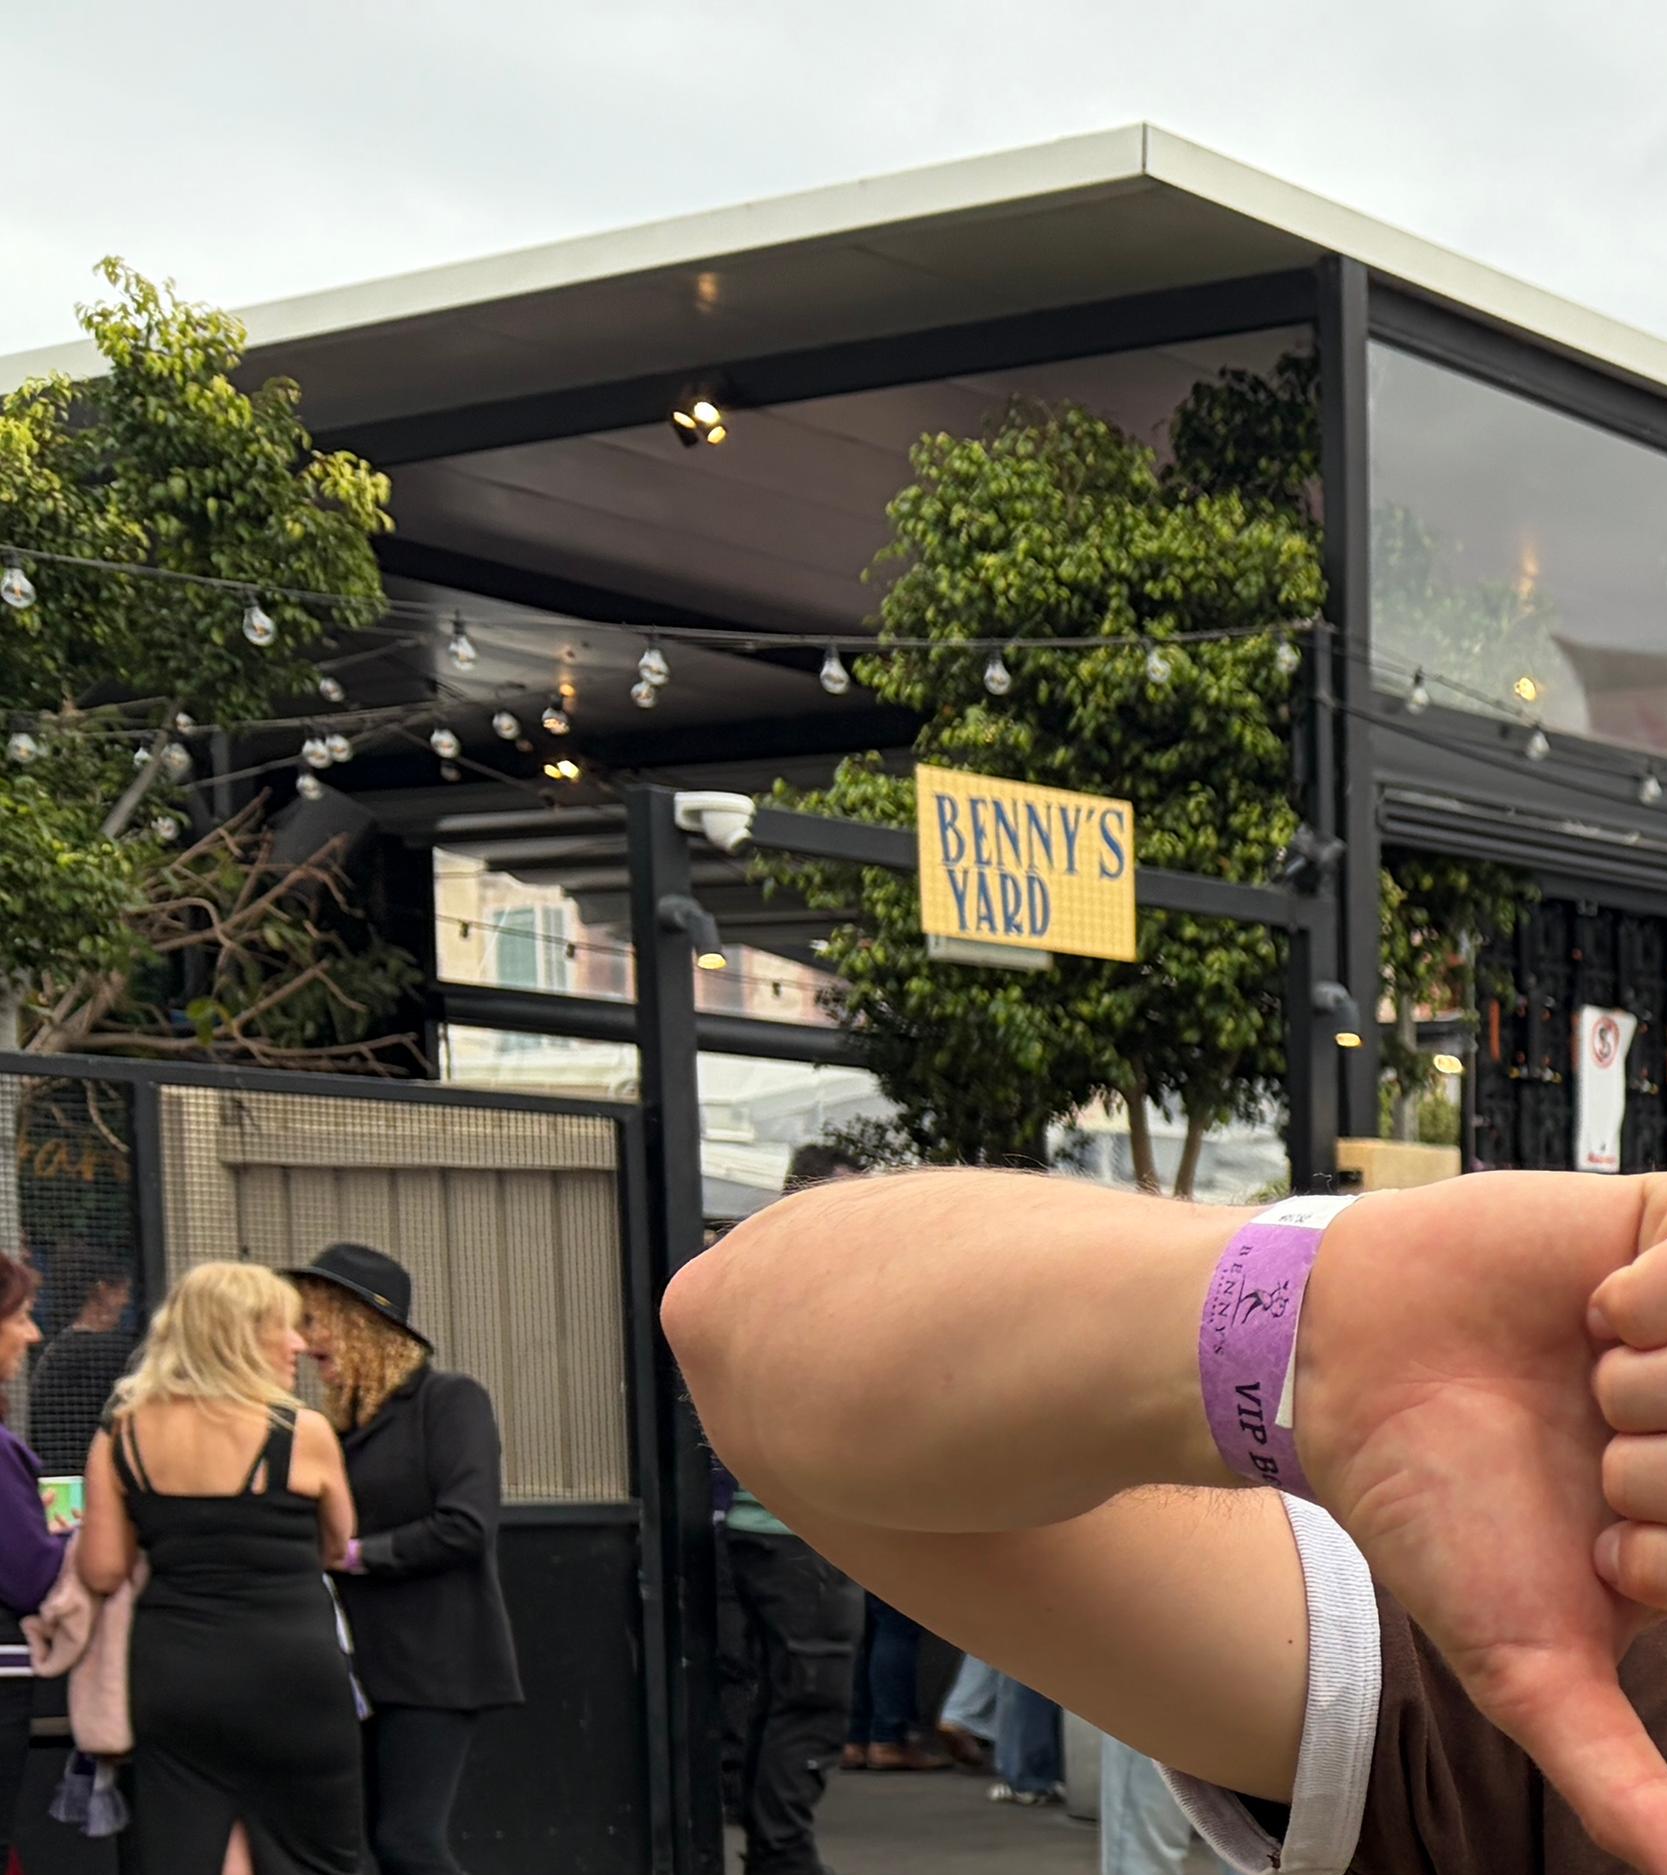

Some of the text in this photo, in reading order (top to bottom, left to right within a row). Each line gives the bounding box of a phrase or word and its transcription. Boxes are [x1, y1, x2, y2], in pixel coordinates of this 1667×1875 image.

[935, 794, 1125, 880] BENNY'S
[945, 867, 1051, 937] YARD
[1235, 1382, 1268, 1447] VIP
